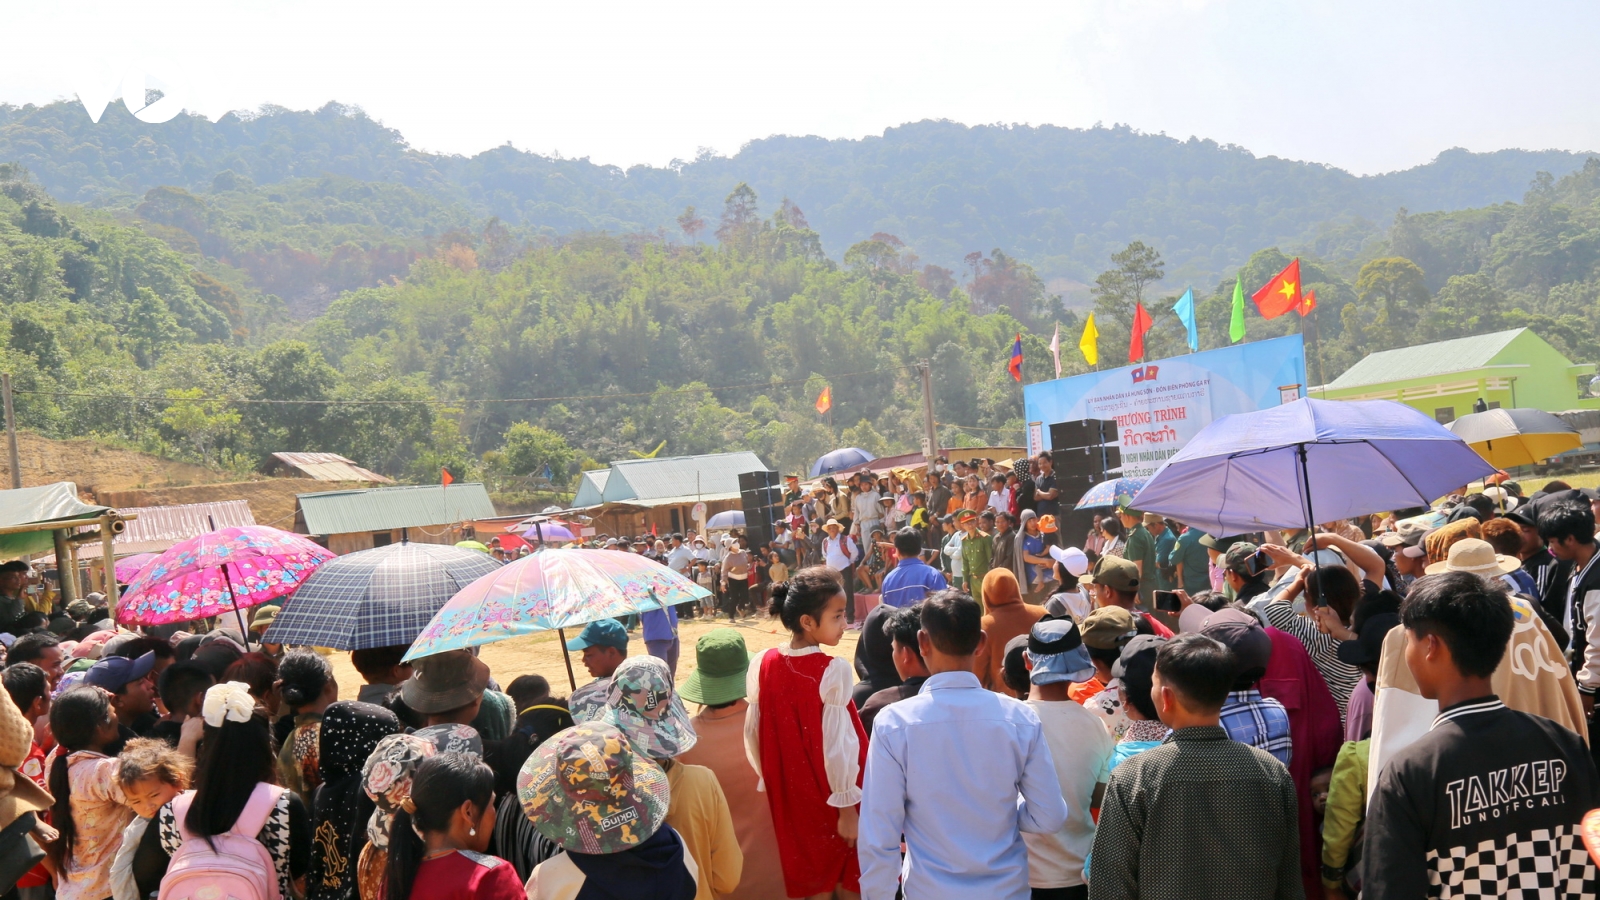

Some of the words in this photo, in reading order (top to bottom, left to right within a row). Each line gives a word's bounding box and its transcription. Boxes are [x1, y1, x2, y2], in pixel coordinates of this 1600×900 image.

[1154, 405, 1187, 422] TRÌNH
[1139, 449, 1154, 462] NHÂN
[1155, 448, 1167, 460] DÂN
[1445, 758, 1567, 829] TAKKEP
[602, 807, 638, 829] taking
